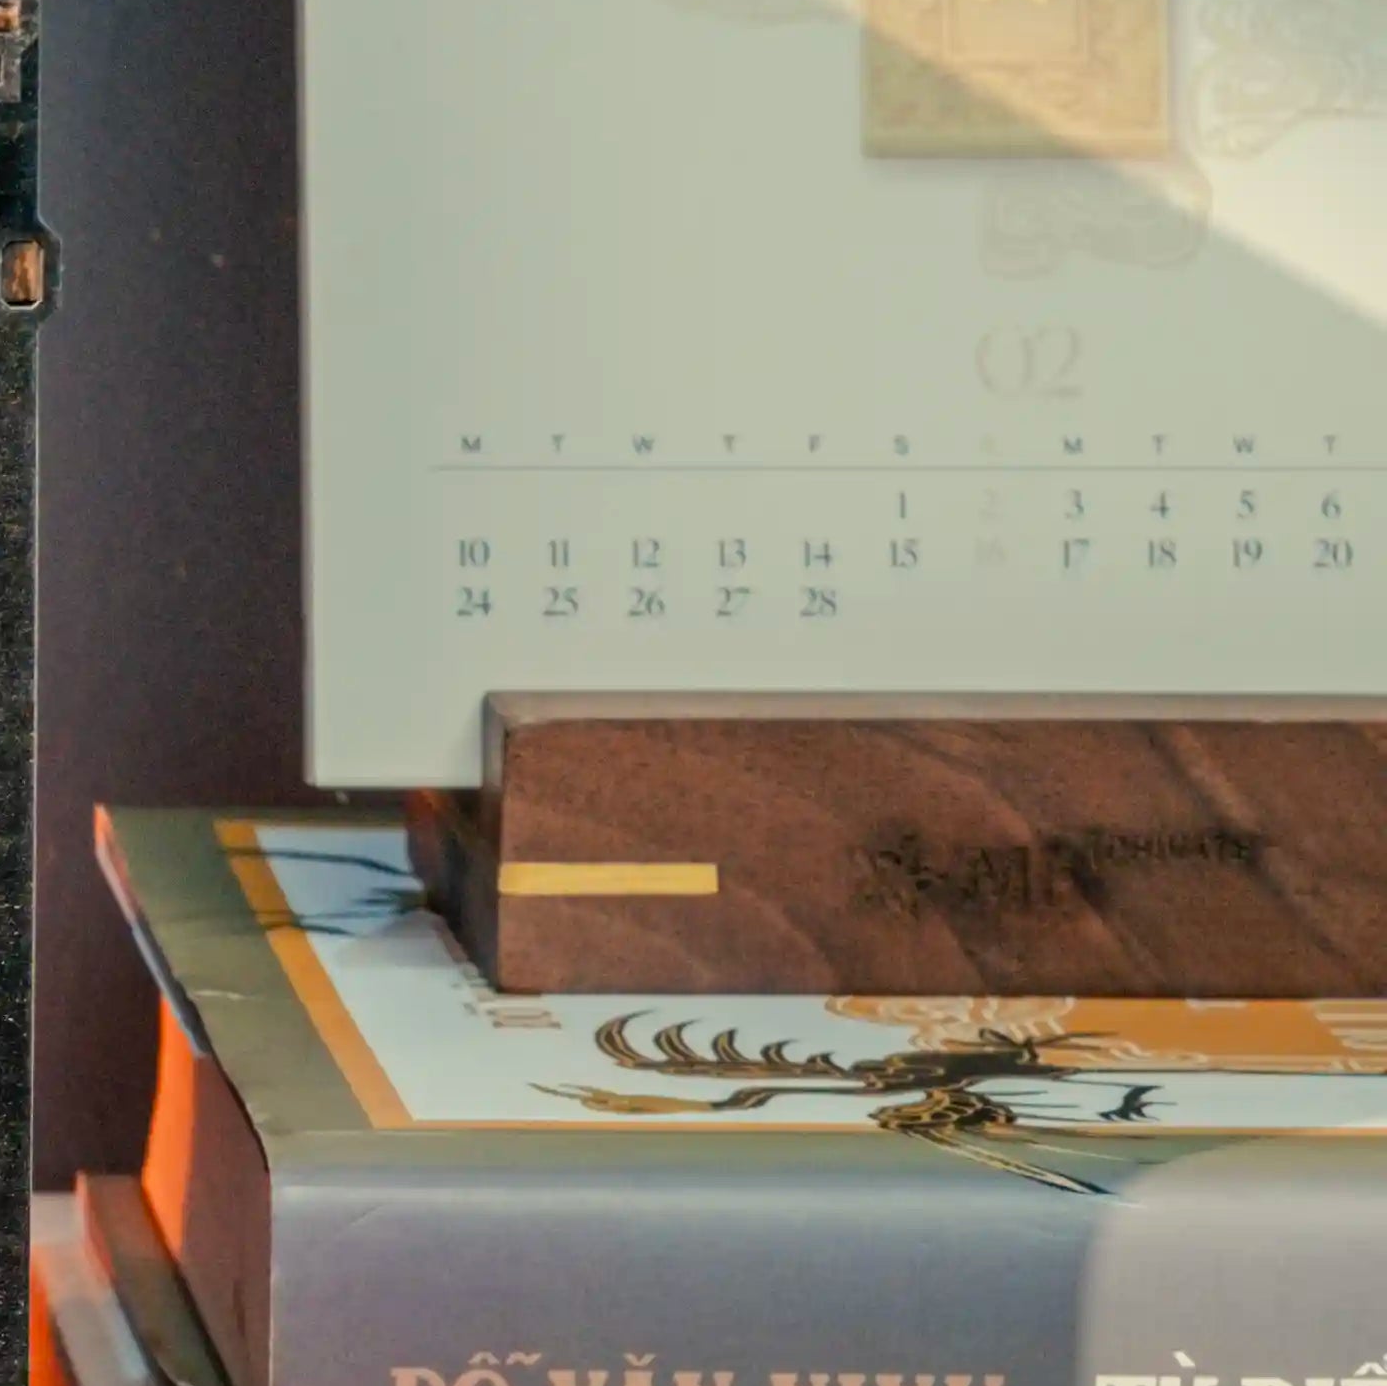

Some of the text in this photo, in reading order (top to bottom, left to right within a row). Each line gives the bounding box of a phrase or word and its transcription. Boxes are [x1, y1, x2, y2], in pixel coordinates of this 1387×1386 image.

[897, 489, 909, 521] 1
[1064, 488, 1086, 520] 3
[1149, 489, 1172, 520] 4
[1236, 488, 1258, 520] 5
[1320, 490, 1343, 520] 6
[457, 537, 492, 569] 10
[547, 537, 571, 569] 11
[630, 537, 663, 569] 12
[716, 537, 749, 569] 13
[802, 537, 835, 570] 14
[888, 537, 921, 570] 15
[1061, 537, 1092, 571] 17
[1147, 537, 1179, 570] 18
[1232, 537, 1265, 570] 19
[1311, 537, 1356, 570] 20
[455, 585, 839, 619] 24 25 26 27 28
